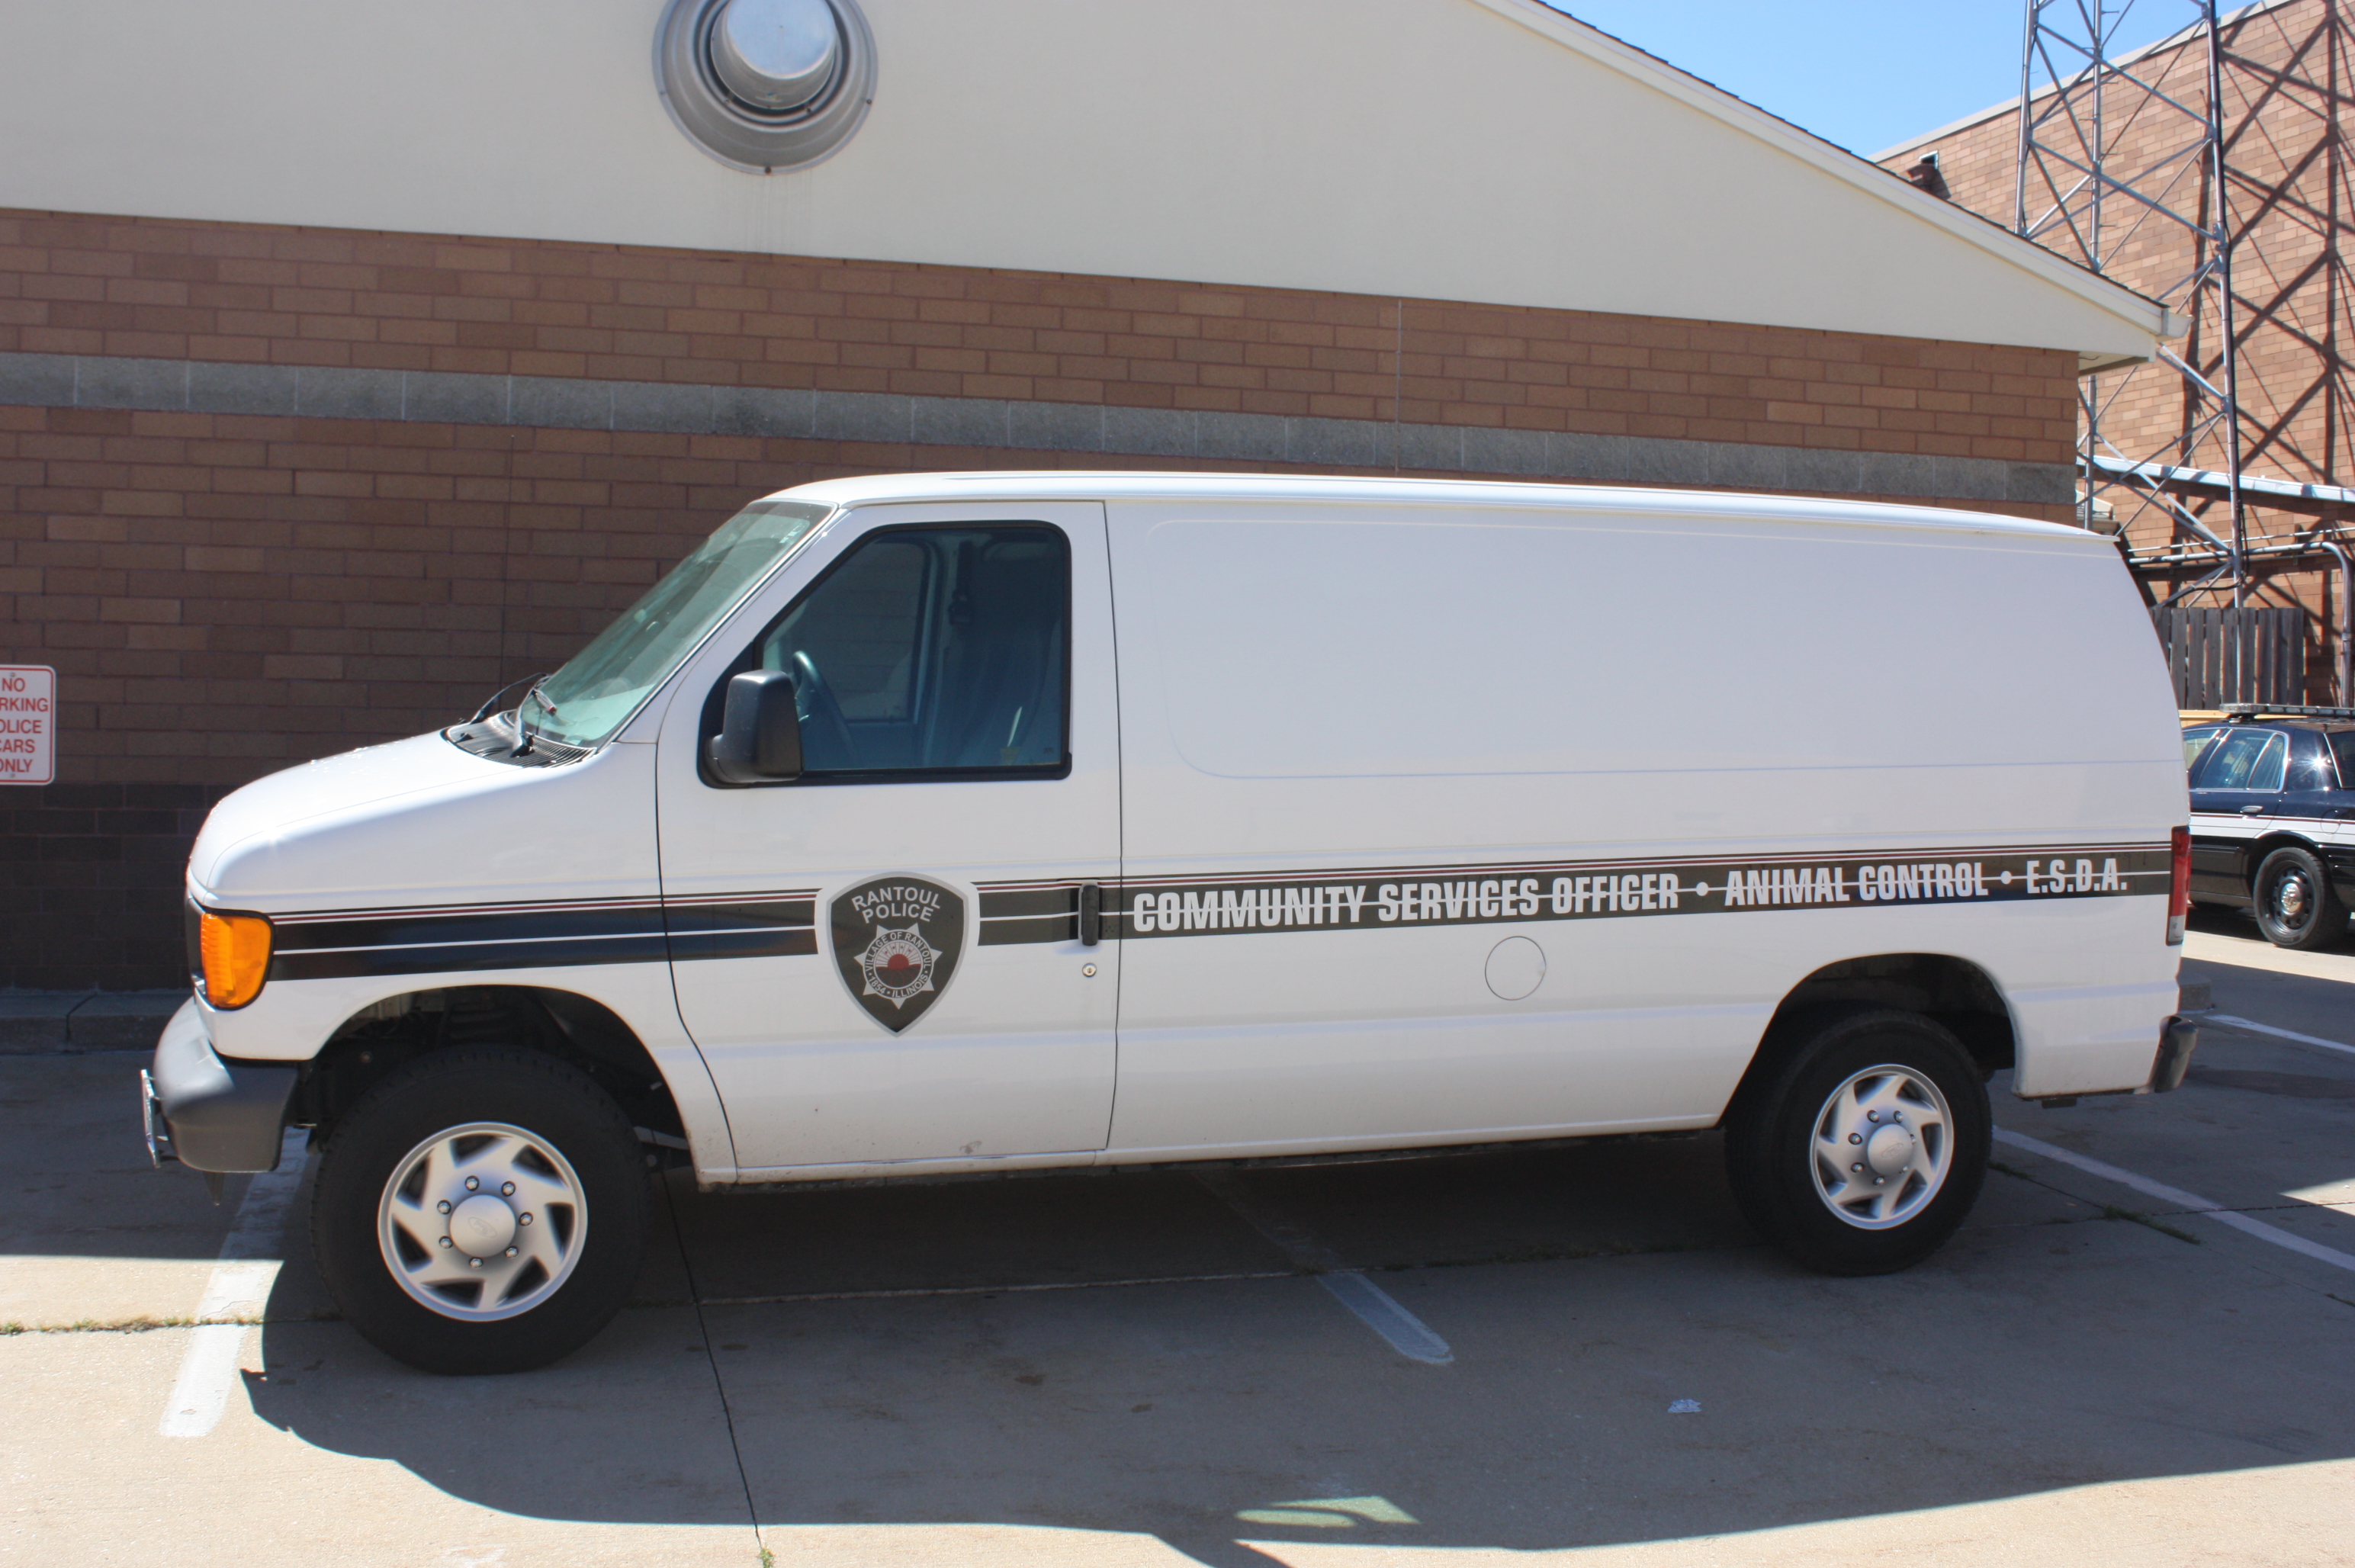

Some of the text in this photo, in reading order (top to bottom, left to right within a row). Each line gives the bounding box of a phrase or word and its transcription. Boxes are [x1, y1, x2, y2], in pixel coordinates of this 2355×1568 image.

[2, 678, 25, 692] NO
[0, 739, 35, 753] ARS
[851, 886, 940, 911] RANTOUL
[1133, 858, 2128, 932] COMMUNITY SERVICES OFFICER ANIMAL CONTROL E.S.D.A.
[862, 903, 934, 924] POLICE
[865, 931, 931, 972] VILLAGE OF RANTOUL
[869, 973, 928, 998] 1854 ILLINOIS
